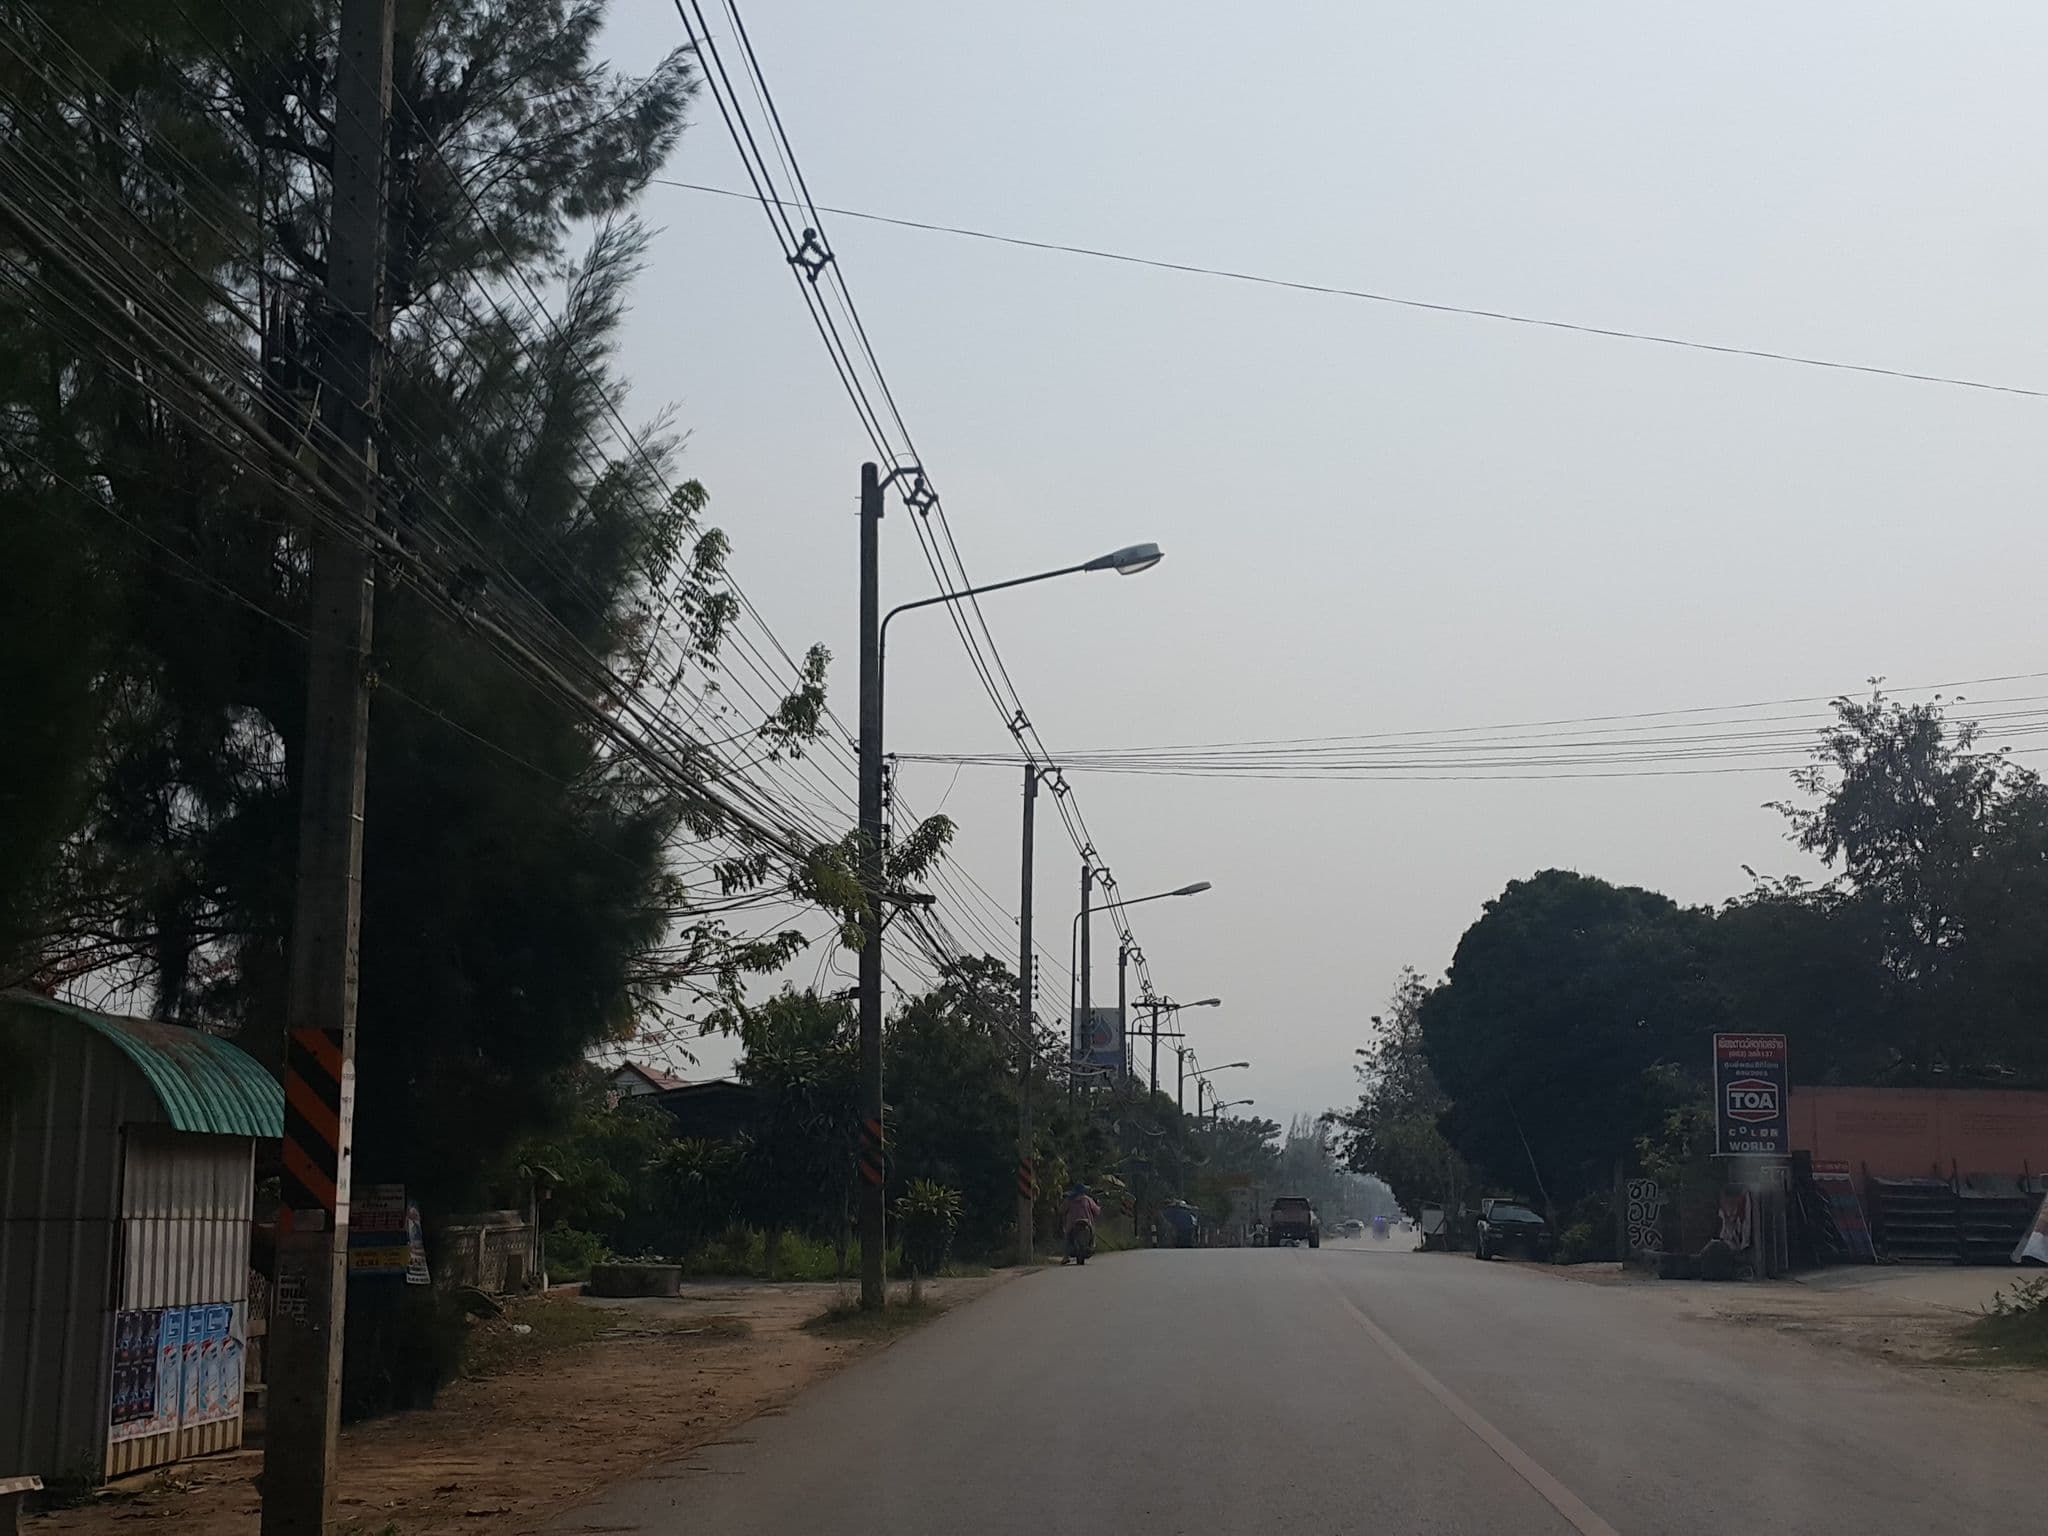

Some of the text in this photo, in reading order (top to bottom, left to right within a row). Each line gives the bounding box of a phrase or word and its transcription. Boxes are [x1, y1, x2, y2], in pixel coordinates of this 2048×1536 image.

[1730, 1092, 1775, 1109] TOA
[1728, 1126, 1778, 1137] COLOR
[1728, 1141, 1776, 1152] WORLD
[1628, 1180, 1658, 1200] ซัก
